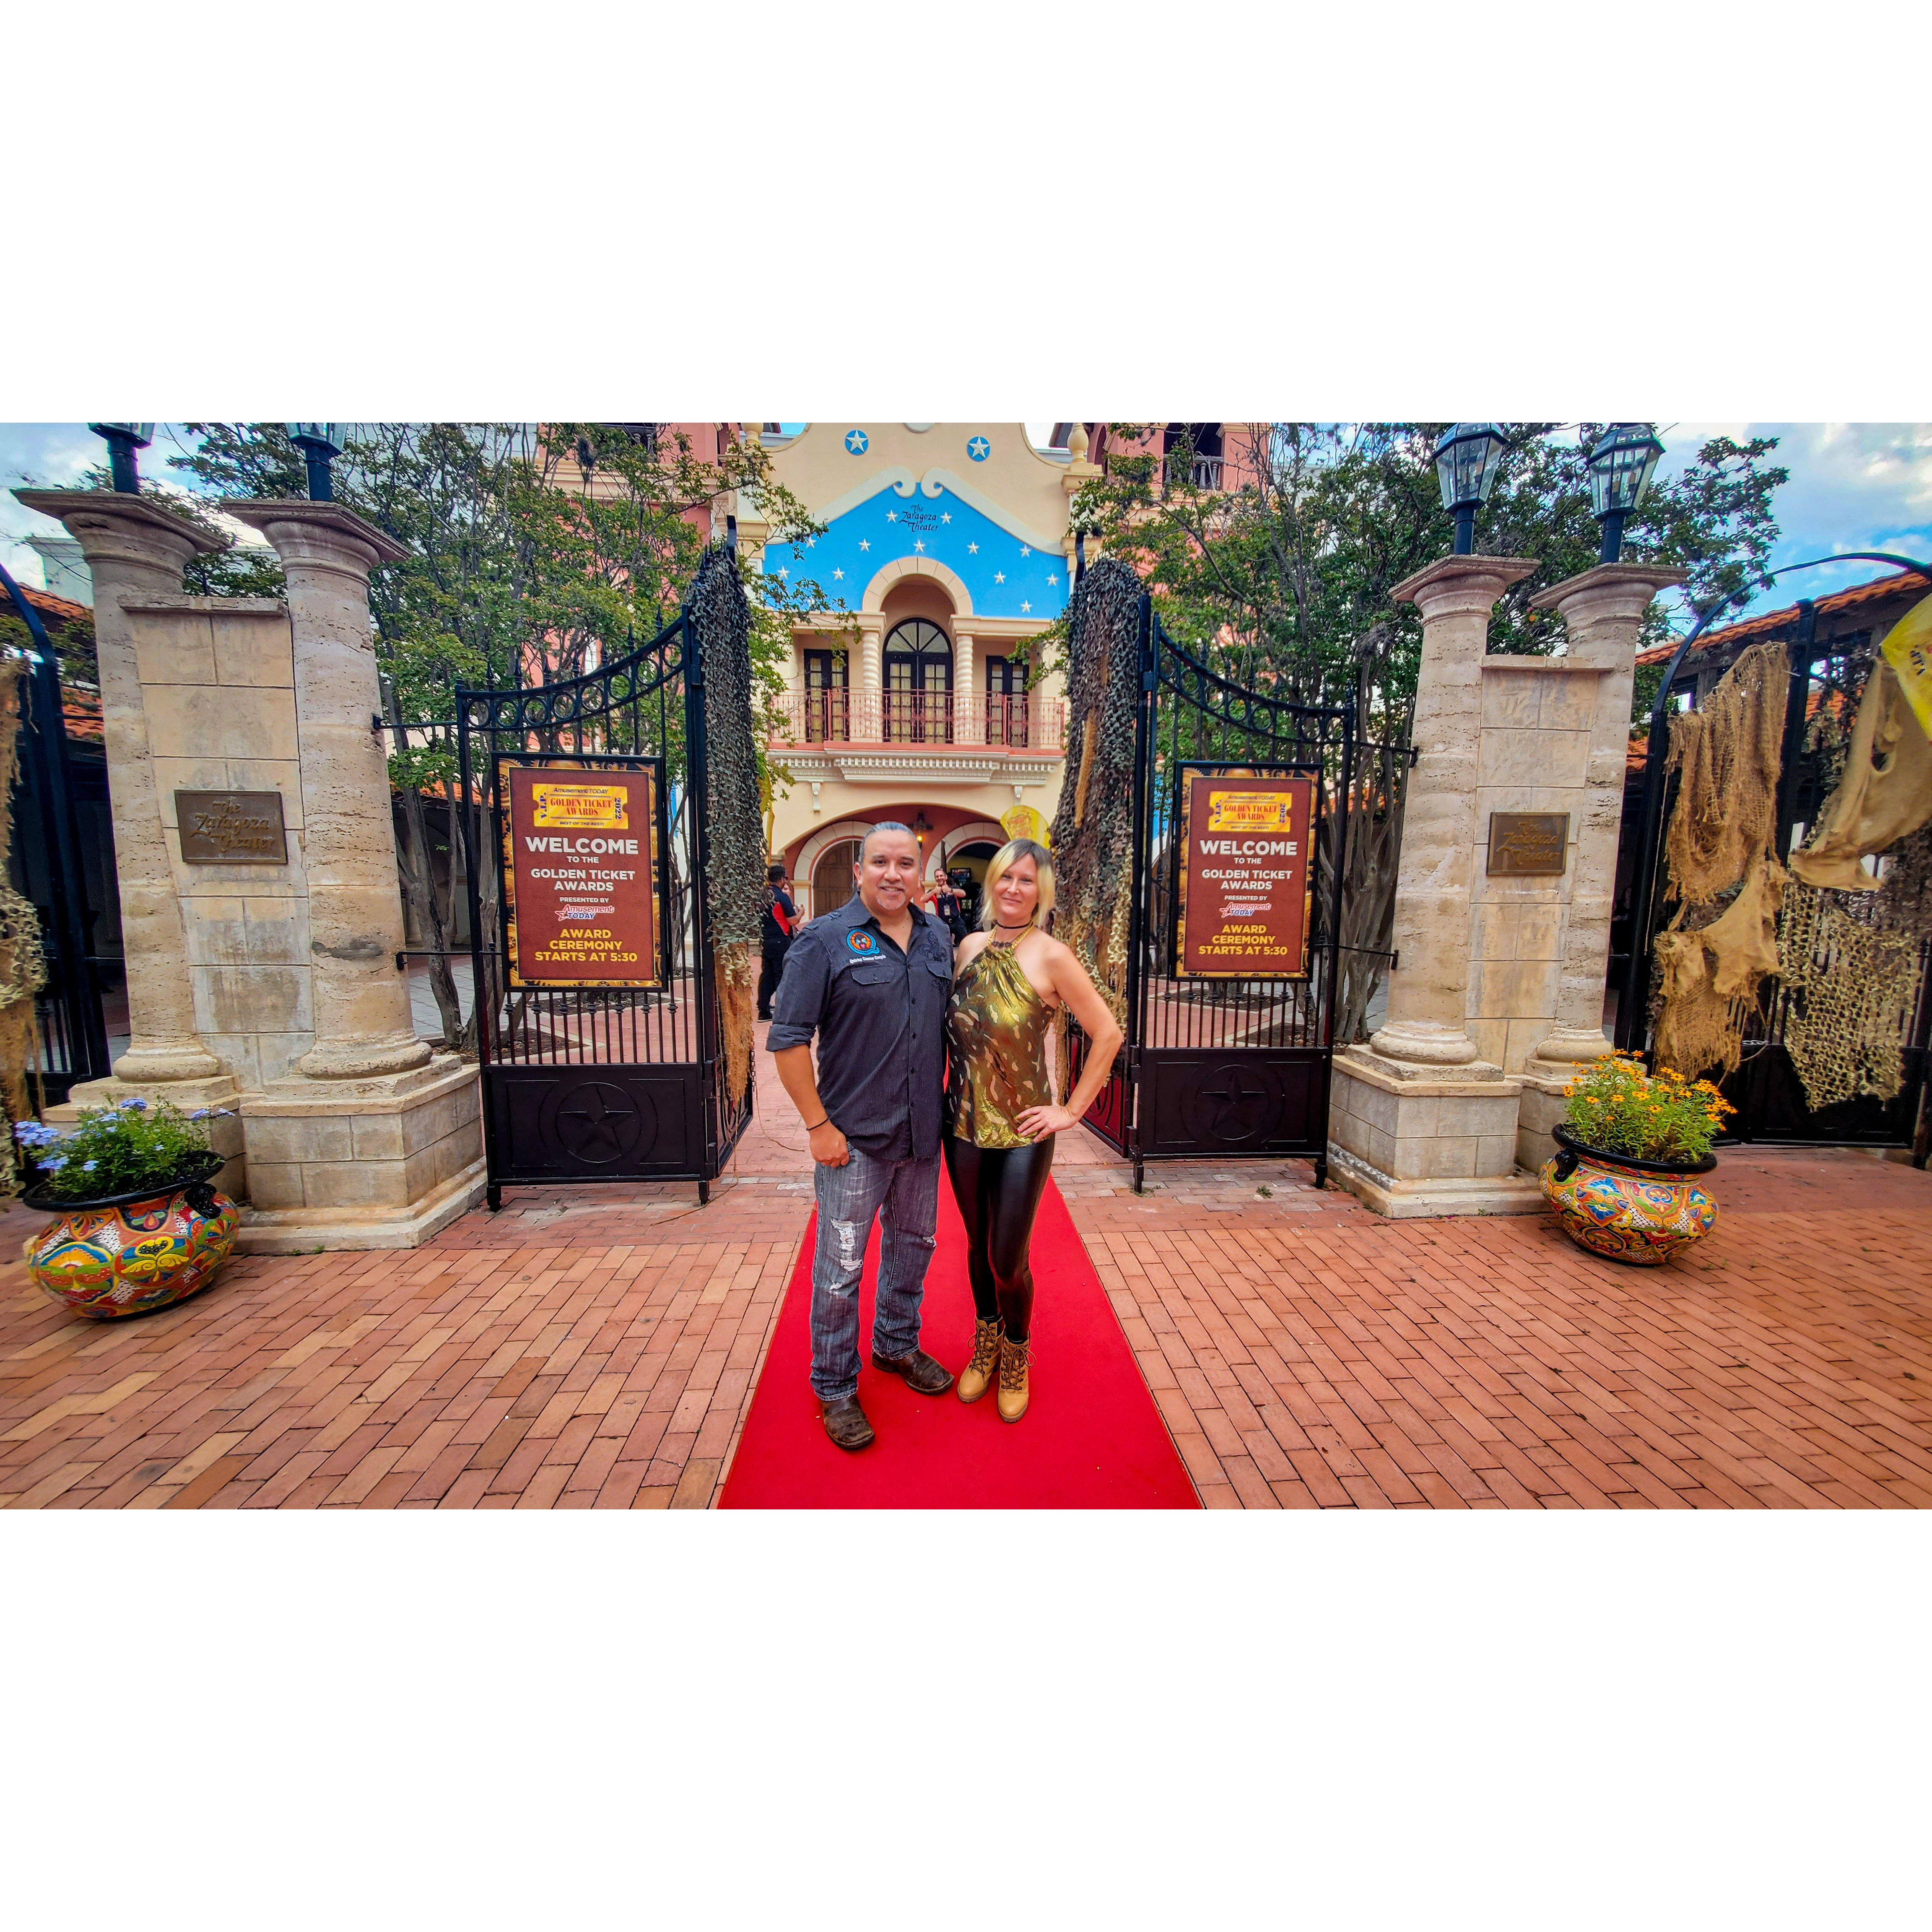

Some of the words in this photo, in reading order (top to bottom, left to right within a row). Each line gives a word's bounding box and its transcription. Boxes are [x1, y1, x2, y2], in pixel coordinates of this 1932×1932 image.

[911, 504, 924, 514] The
[898, 511, 937, 523] Zaragoza
[908, 521, 939, 532] Theater
[212, 800, 241, 814] The
[550, 798, 581, 807] GOLDEN
[584, 799, 612, 808] TICKET
[189, 813, 270, 838] Zaragoza
[210, 832, 275, 853] Theater
[525, 836, 639, 854] WELCOME
[1200, 840, 1298, 855] WELCOME
[1496, 832, 1559, 853] Zaragoza
[1510, 846, 1560, 866] Theater
[531, 868, 586, 879] GOLDEN
[589, 870, 635, 880] TICKET
[1202, 869, 1249, 879] GOLDEN
[1252, 870, 1293, 879] TICKET
[553, 881, 614, 891] AWARDS
[1220, 880, 1272, 890] AWARDS
[563, 904, 615, 913] Amusement
[1226, 902, 1271, 910] Amusement
[560, 928, 611, 938] AWARD
[1222, 924, 1267, 933] AWARD
[1212, 935, 1276, 944] CEREMONY
[549, 940, 623, 950] CEREMONY
[1198, 945, 1243, 955] STARTS
[1245, 946, 1262, 955] AT
[1263, 946, 1288, 955] 5:30
[535, 951, 586, 961] STARTS
[589, 952, 607, 961] AT
[610, 952, 637, 962] 5:30
